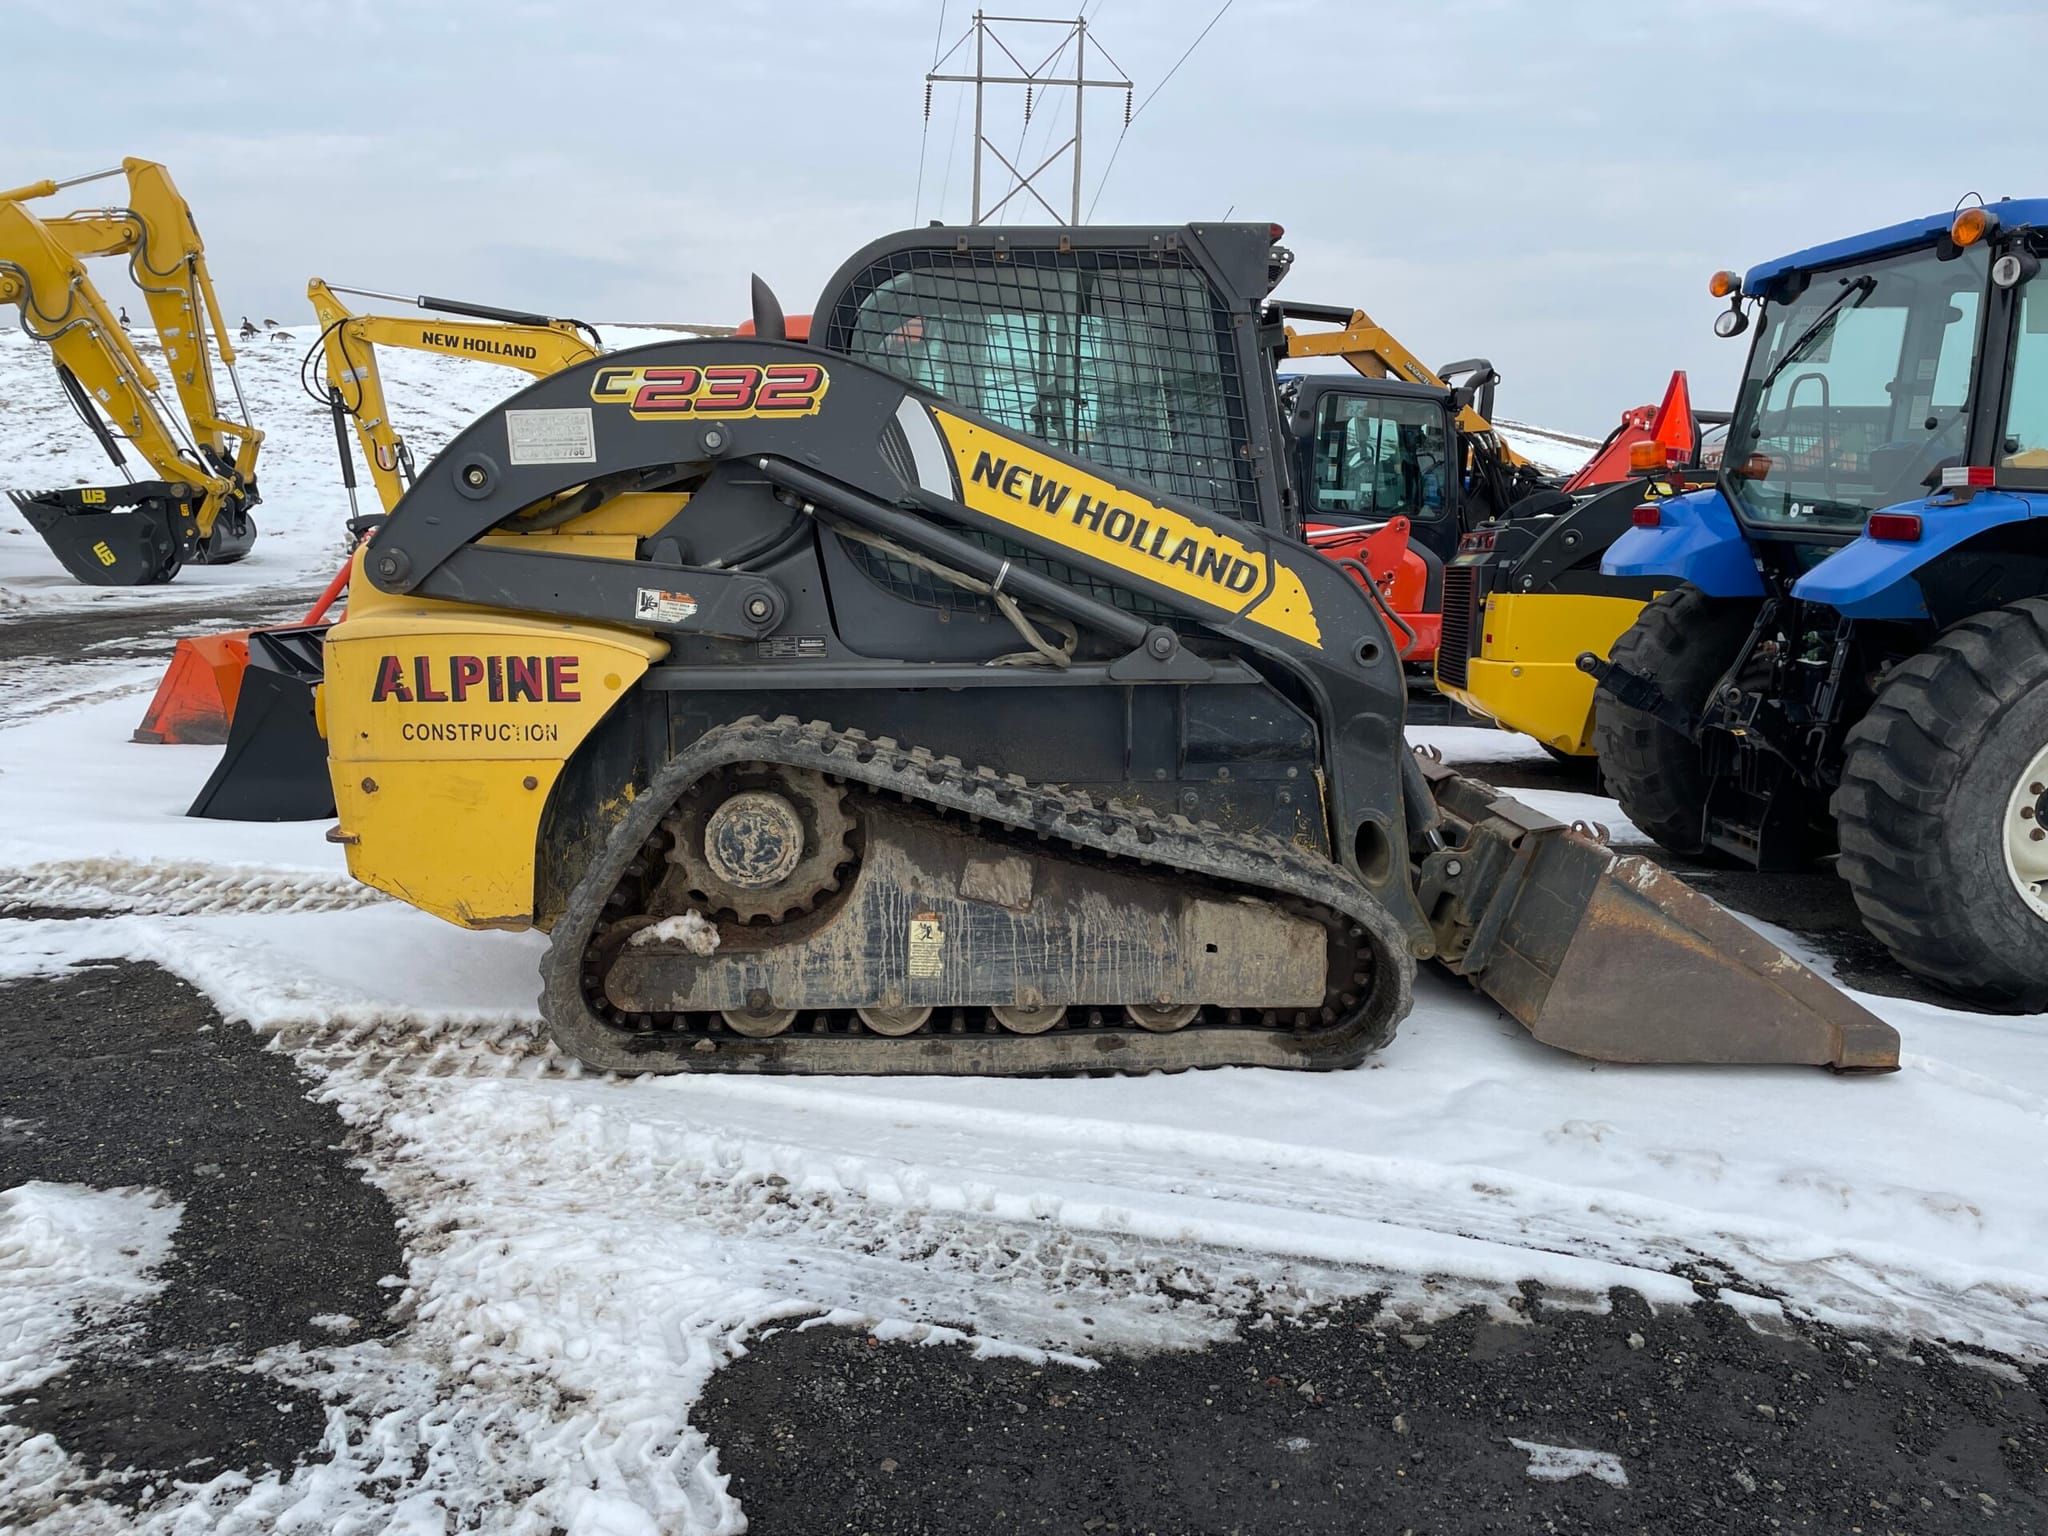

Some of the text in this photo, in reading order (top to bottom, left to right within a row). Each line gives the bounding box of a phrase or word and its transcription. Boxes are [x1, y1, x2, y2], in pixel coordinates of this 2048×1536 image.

[422, 331, 537, 359] NEW HOLLAND
[971, 451, 1258, 594] NEW HOLLAND
[371, 656, 582, 702] ALPINE
